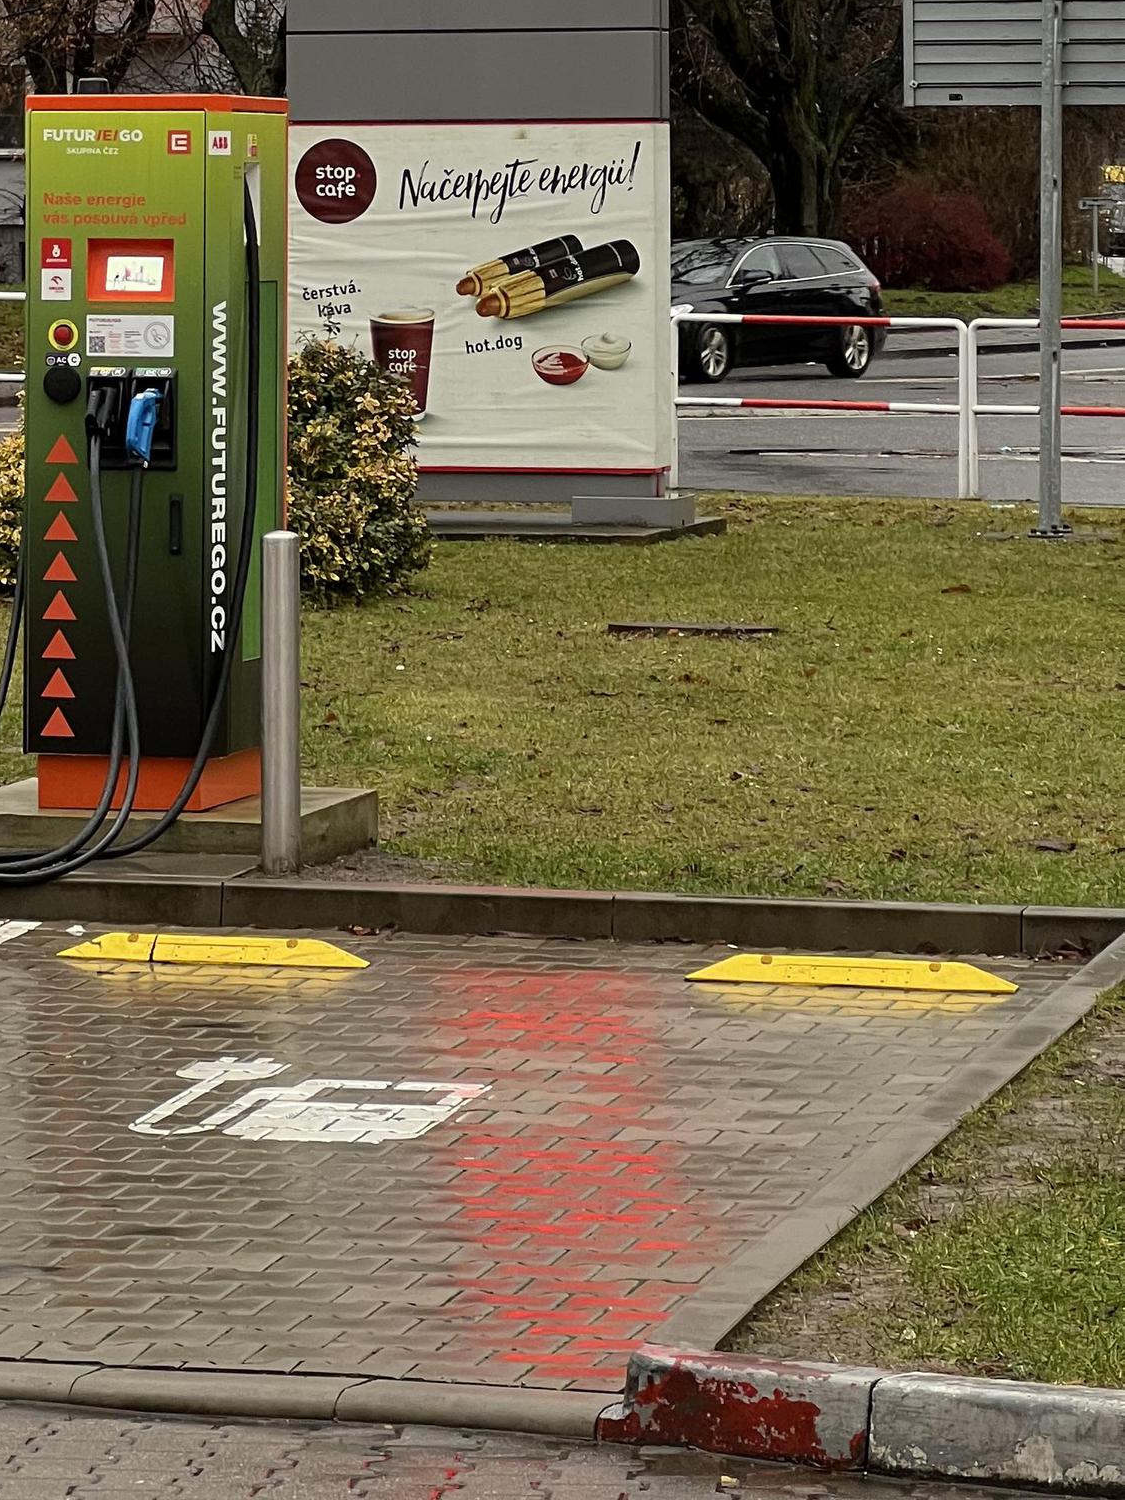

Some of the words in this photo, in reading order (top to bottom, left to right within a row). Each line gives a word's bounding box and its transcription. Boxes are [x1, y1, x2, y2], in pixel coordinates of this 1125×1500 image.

[212, 136, 228, 149] ABB
[316, 164, 356, 183] stop
[316, 181, 356, 198] cafe
[399, 159, 539, 224] Načerpejte
[539, 141, 641, 214] energii!
[43, 192, 82, 206] Naše
[87, 194, 146, 208] energie
[43, 211, 68, 224] vás
[73, 211, 138, 227] posouvá
[143, 212, 187, 227] vpřed
[302, 280, 362, 300] čerstvá.
[317, 303, 352, 317] káva
[465, 334, 523, 354] hot.dog
[56, 356, 67, 364] AC
[388, 348, 416, 361] stop
[388, 360, 416, 373] cafe
[211, 300, 227, 653] WWW.FUTUREGO.CZ
